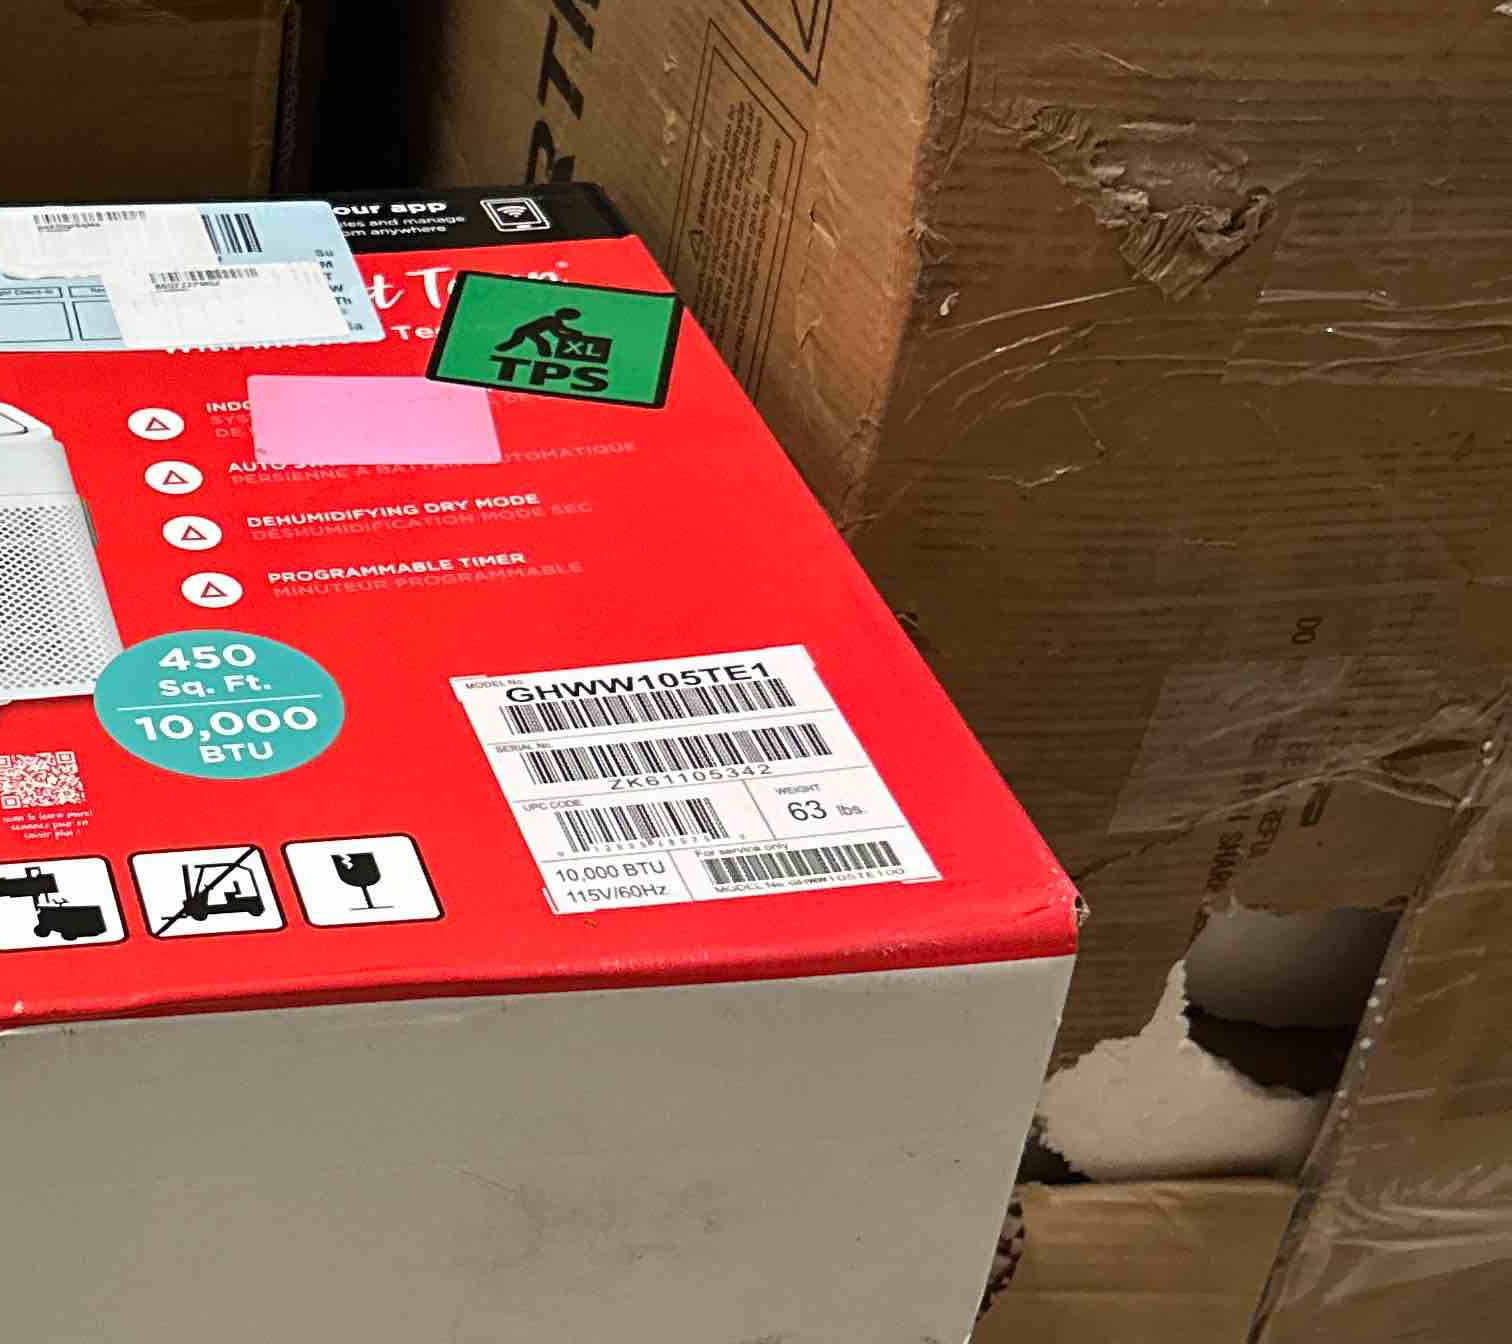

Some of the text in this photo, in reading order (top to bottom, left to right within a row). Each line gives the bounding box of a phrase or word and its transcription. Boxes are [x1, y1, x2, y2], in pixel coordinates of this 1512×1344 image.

[332, 201, 447, 216] our app
[370, 226, 447, 237] anywhere
[563, 341, 598, 358] XL
[489, 354, 609, 393] TPS
[205, 400, 251, 414] INDO
[246, 493, 541, 529] DEHUMIDIFYING DRY MODE
[267, 551, 527, 585] PROGRAMMABLE TIMER
[273, 561, 585, 600] MINUTEUR PROGRAMMABLE
[158, 643, 257, 671] 450
[158, 673, 272, 698] Sq. Ft.
[505, 662, 772, 704] GHWW105TE1
[135, 705, 319, 742] 10,000
[199, 741, 274, 765] BTU
[610, 763, 773, 791] ZK61105342
[775, 782, 822, 795] WEIGHT
[522, 799, 584, 813] UPC CODE
[787, 798, 828, 822] 63
[718, 845, 762, 856] service
[763, 842, 789, 854] only
[555, 859, 666, 883] 10,000 BTU
[566, 884, 668, 904] 115V/60Hz
